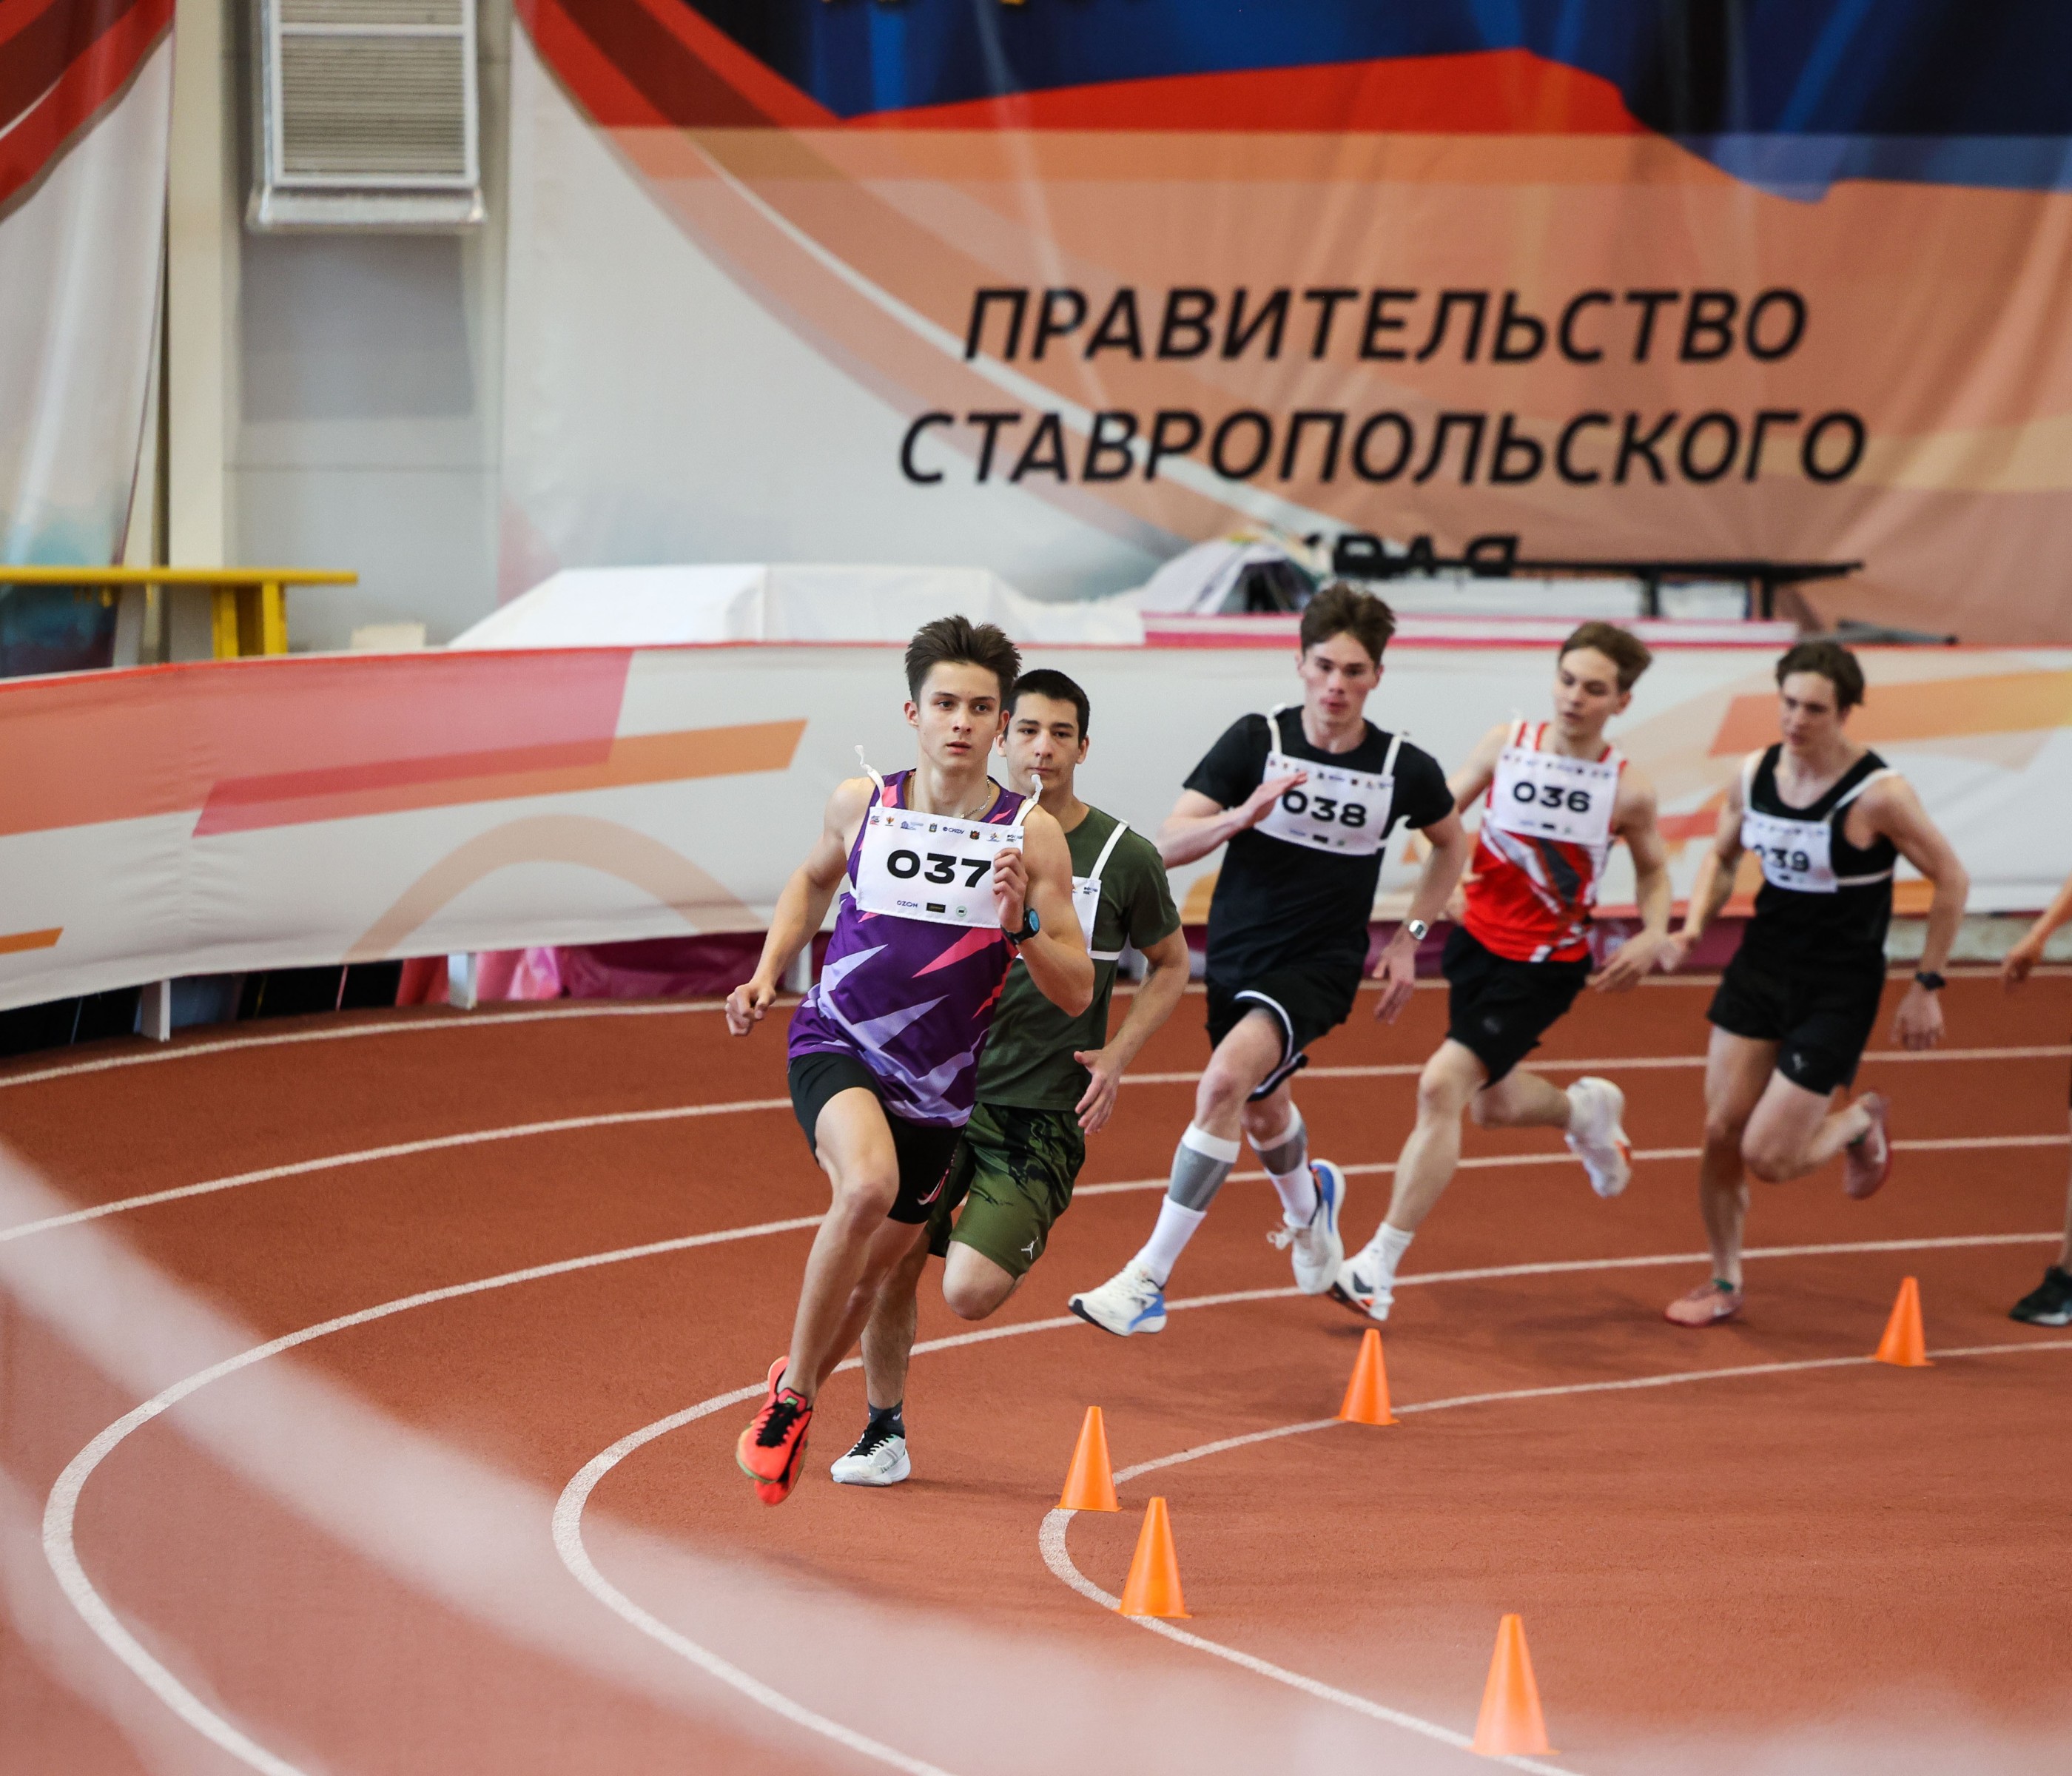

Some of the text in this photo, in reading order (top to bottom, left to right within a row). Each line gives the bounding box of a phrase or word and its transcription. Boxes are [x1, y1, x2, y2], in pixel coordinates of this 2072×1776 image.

[963, 283, 1810, 366] ПРАВИТЕЛЬСТВО
[898, 406, 1869, 488] СТАВРОПОЛЬСКОГО
[1282, 790, 1367, 828] 038
[1513, 781, 1591, 813] 036
[887, 849, 992, 888] 037
[896, 900, 918, 908] OZON
